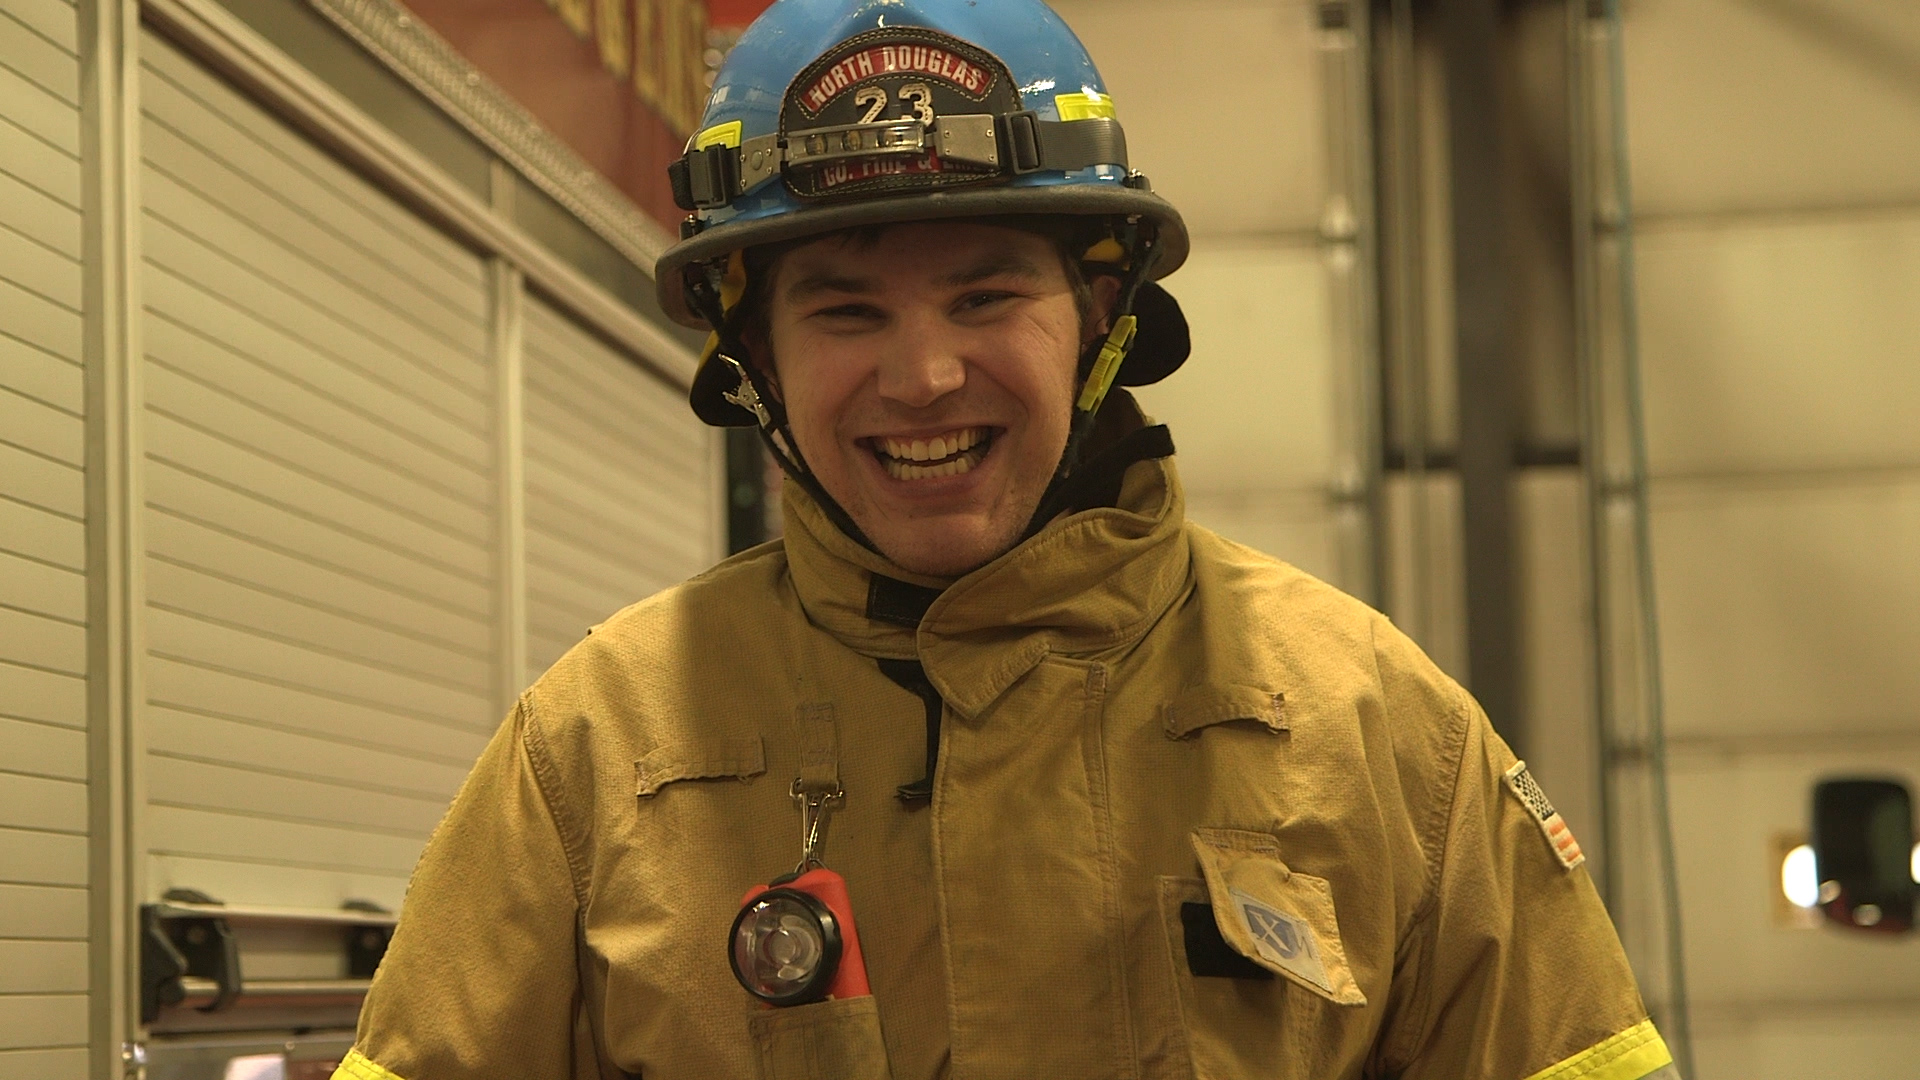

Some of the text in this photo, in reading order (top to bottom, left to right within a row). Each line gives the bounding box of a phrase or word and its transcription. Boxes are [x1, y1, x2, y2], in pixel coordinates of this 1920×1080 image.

[808, 45, 983, 106] NORTH DOUGLAS
[855, 82, 934, 127] 23
